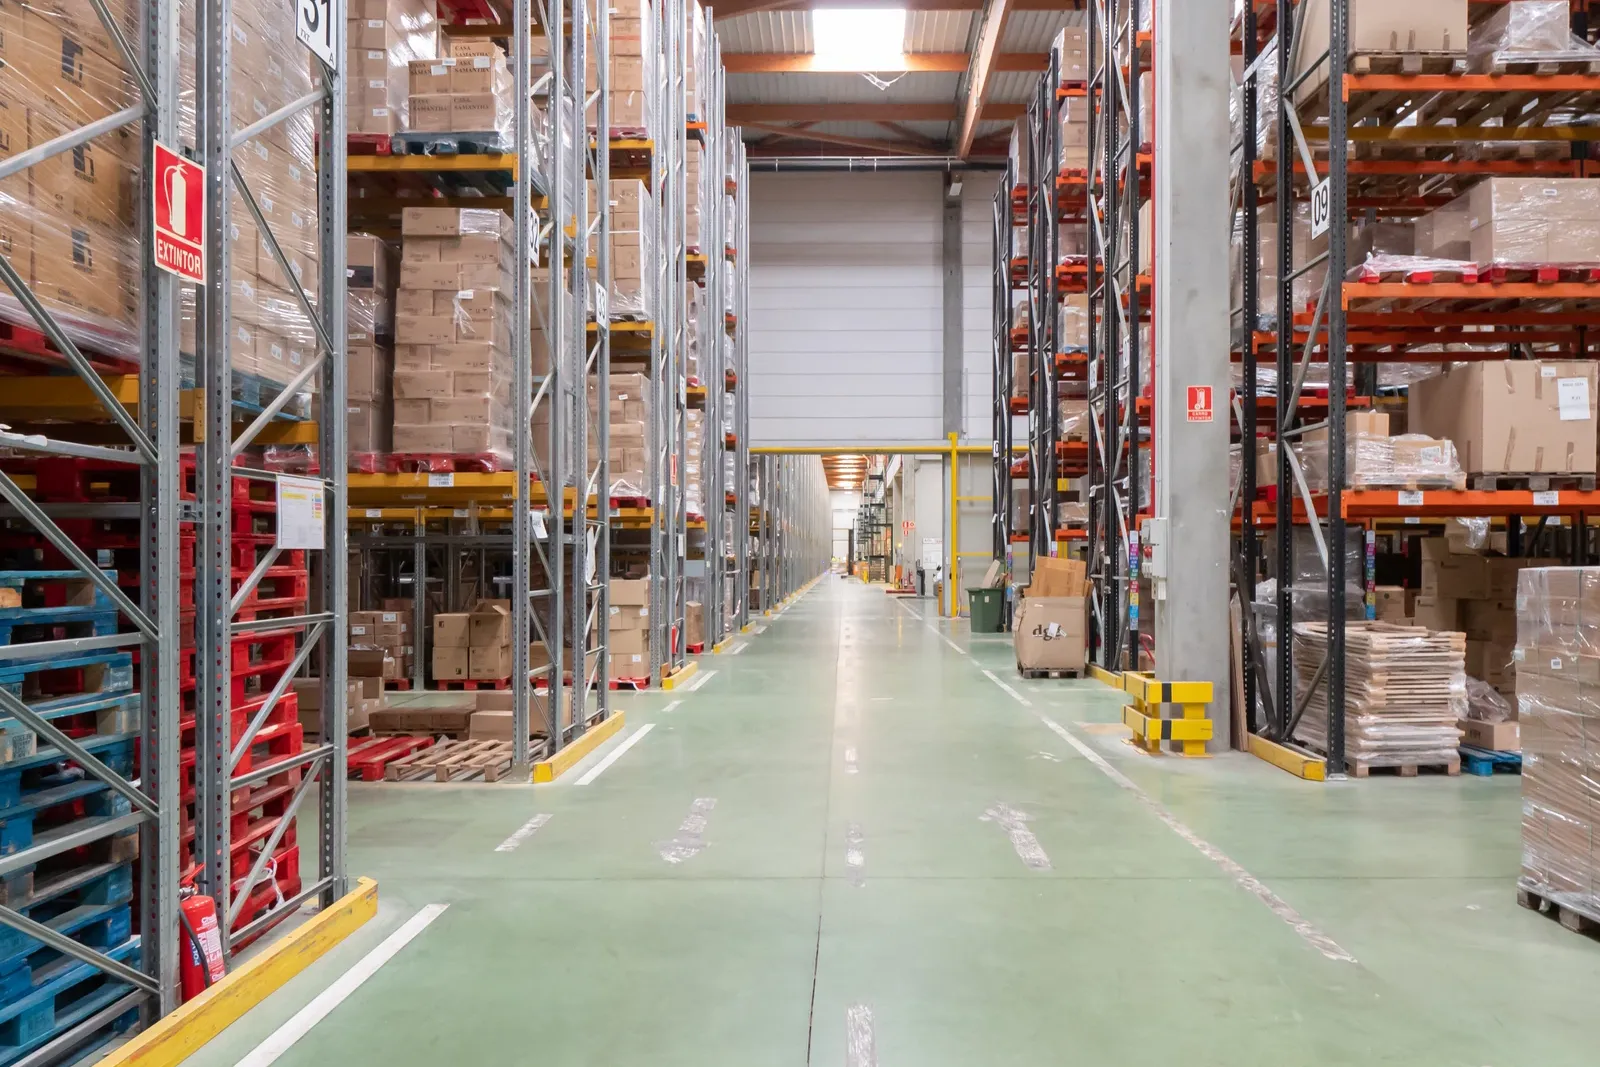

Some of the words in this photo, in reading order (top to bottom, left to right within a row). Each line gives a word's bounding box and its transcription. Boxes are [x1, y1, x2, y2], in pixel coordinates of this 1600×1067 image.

[303, 0, 330, 49] 31
[329, 52, 335, 66] A
[1314, 184, 1328, 227] 09
[157, 238, 202, 276] EXTINTOR
